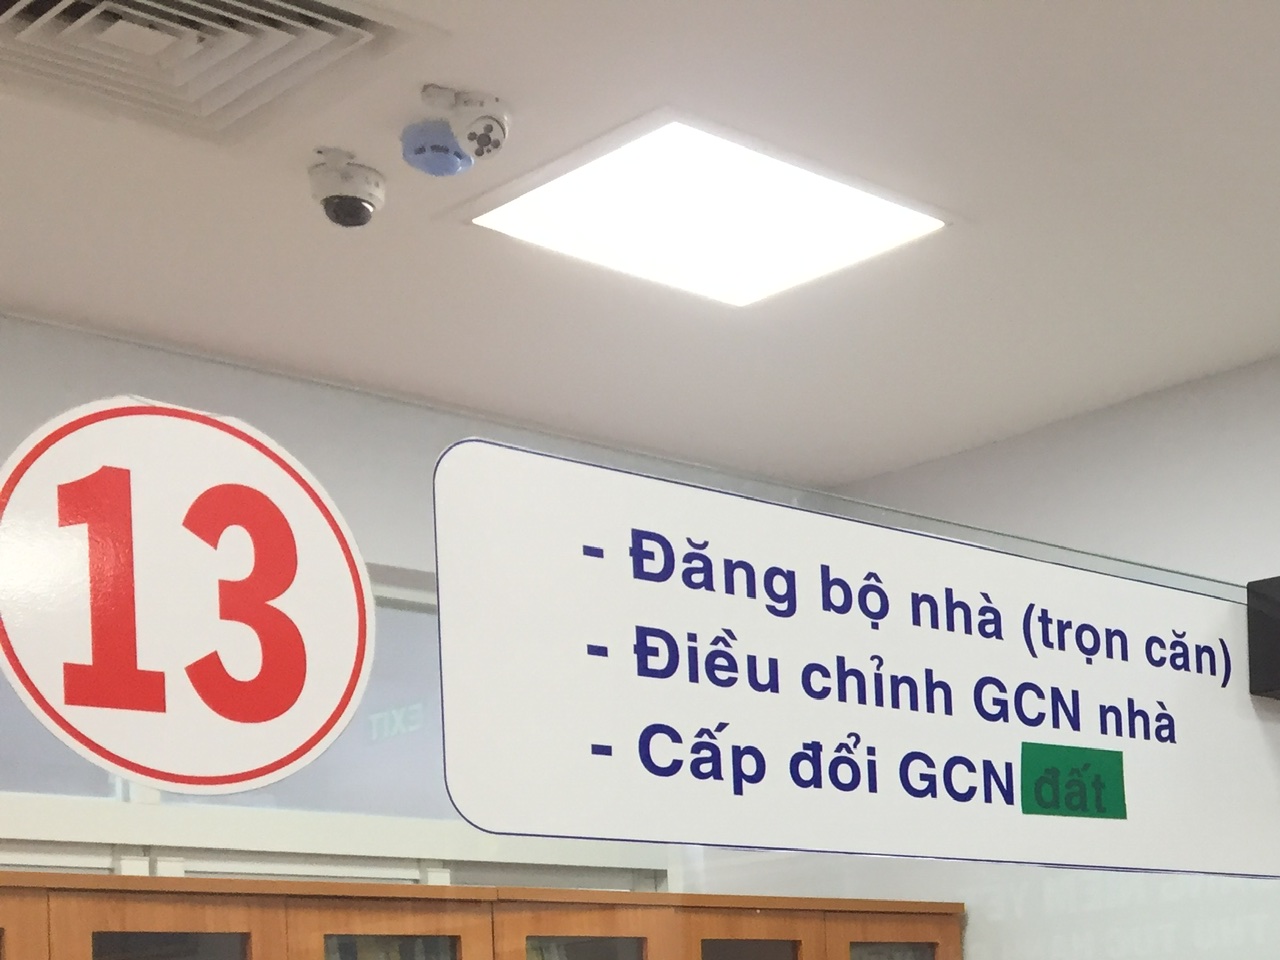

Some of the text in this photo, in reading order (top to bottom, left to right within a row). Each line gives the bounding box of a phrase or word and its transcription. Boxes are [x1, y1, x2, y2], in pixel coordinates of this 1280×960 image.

[57, 465, 307, 724] 13
[629, 528, 1232, 688] Đăng bộ nhà (trọn căn)
[633, 625, 1177, 744] Điều chỉnh GCN nhà
[638, 722, 766, 796] Cấp
[789, 732, 878, 793] đổi
[899, 750, 1015, 805] GCN
